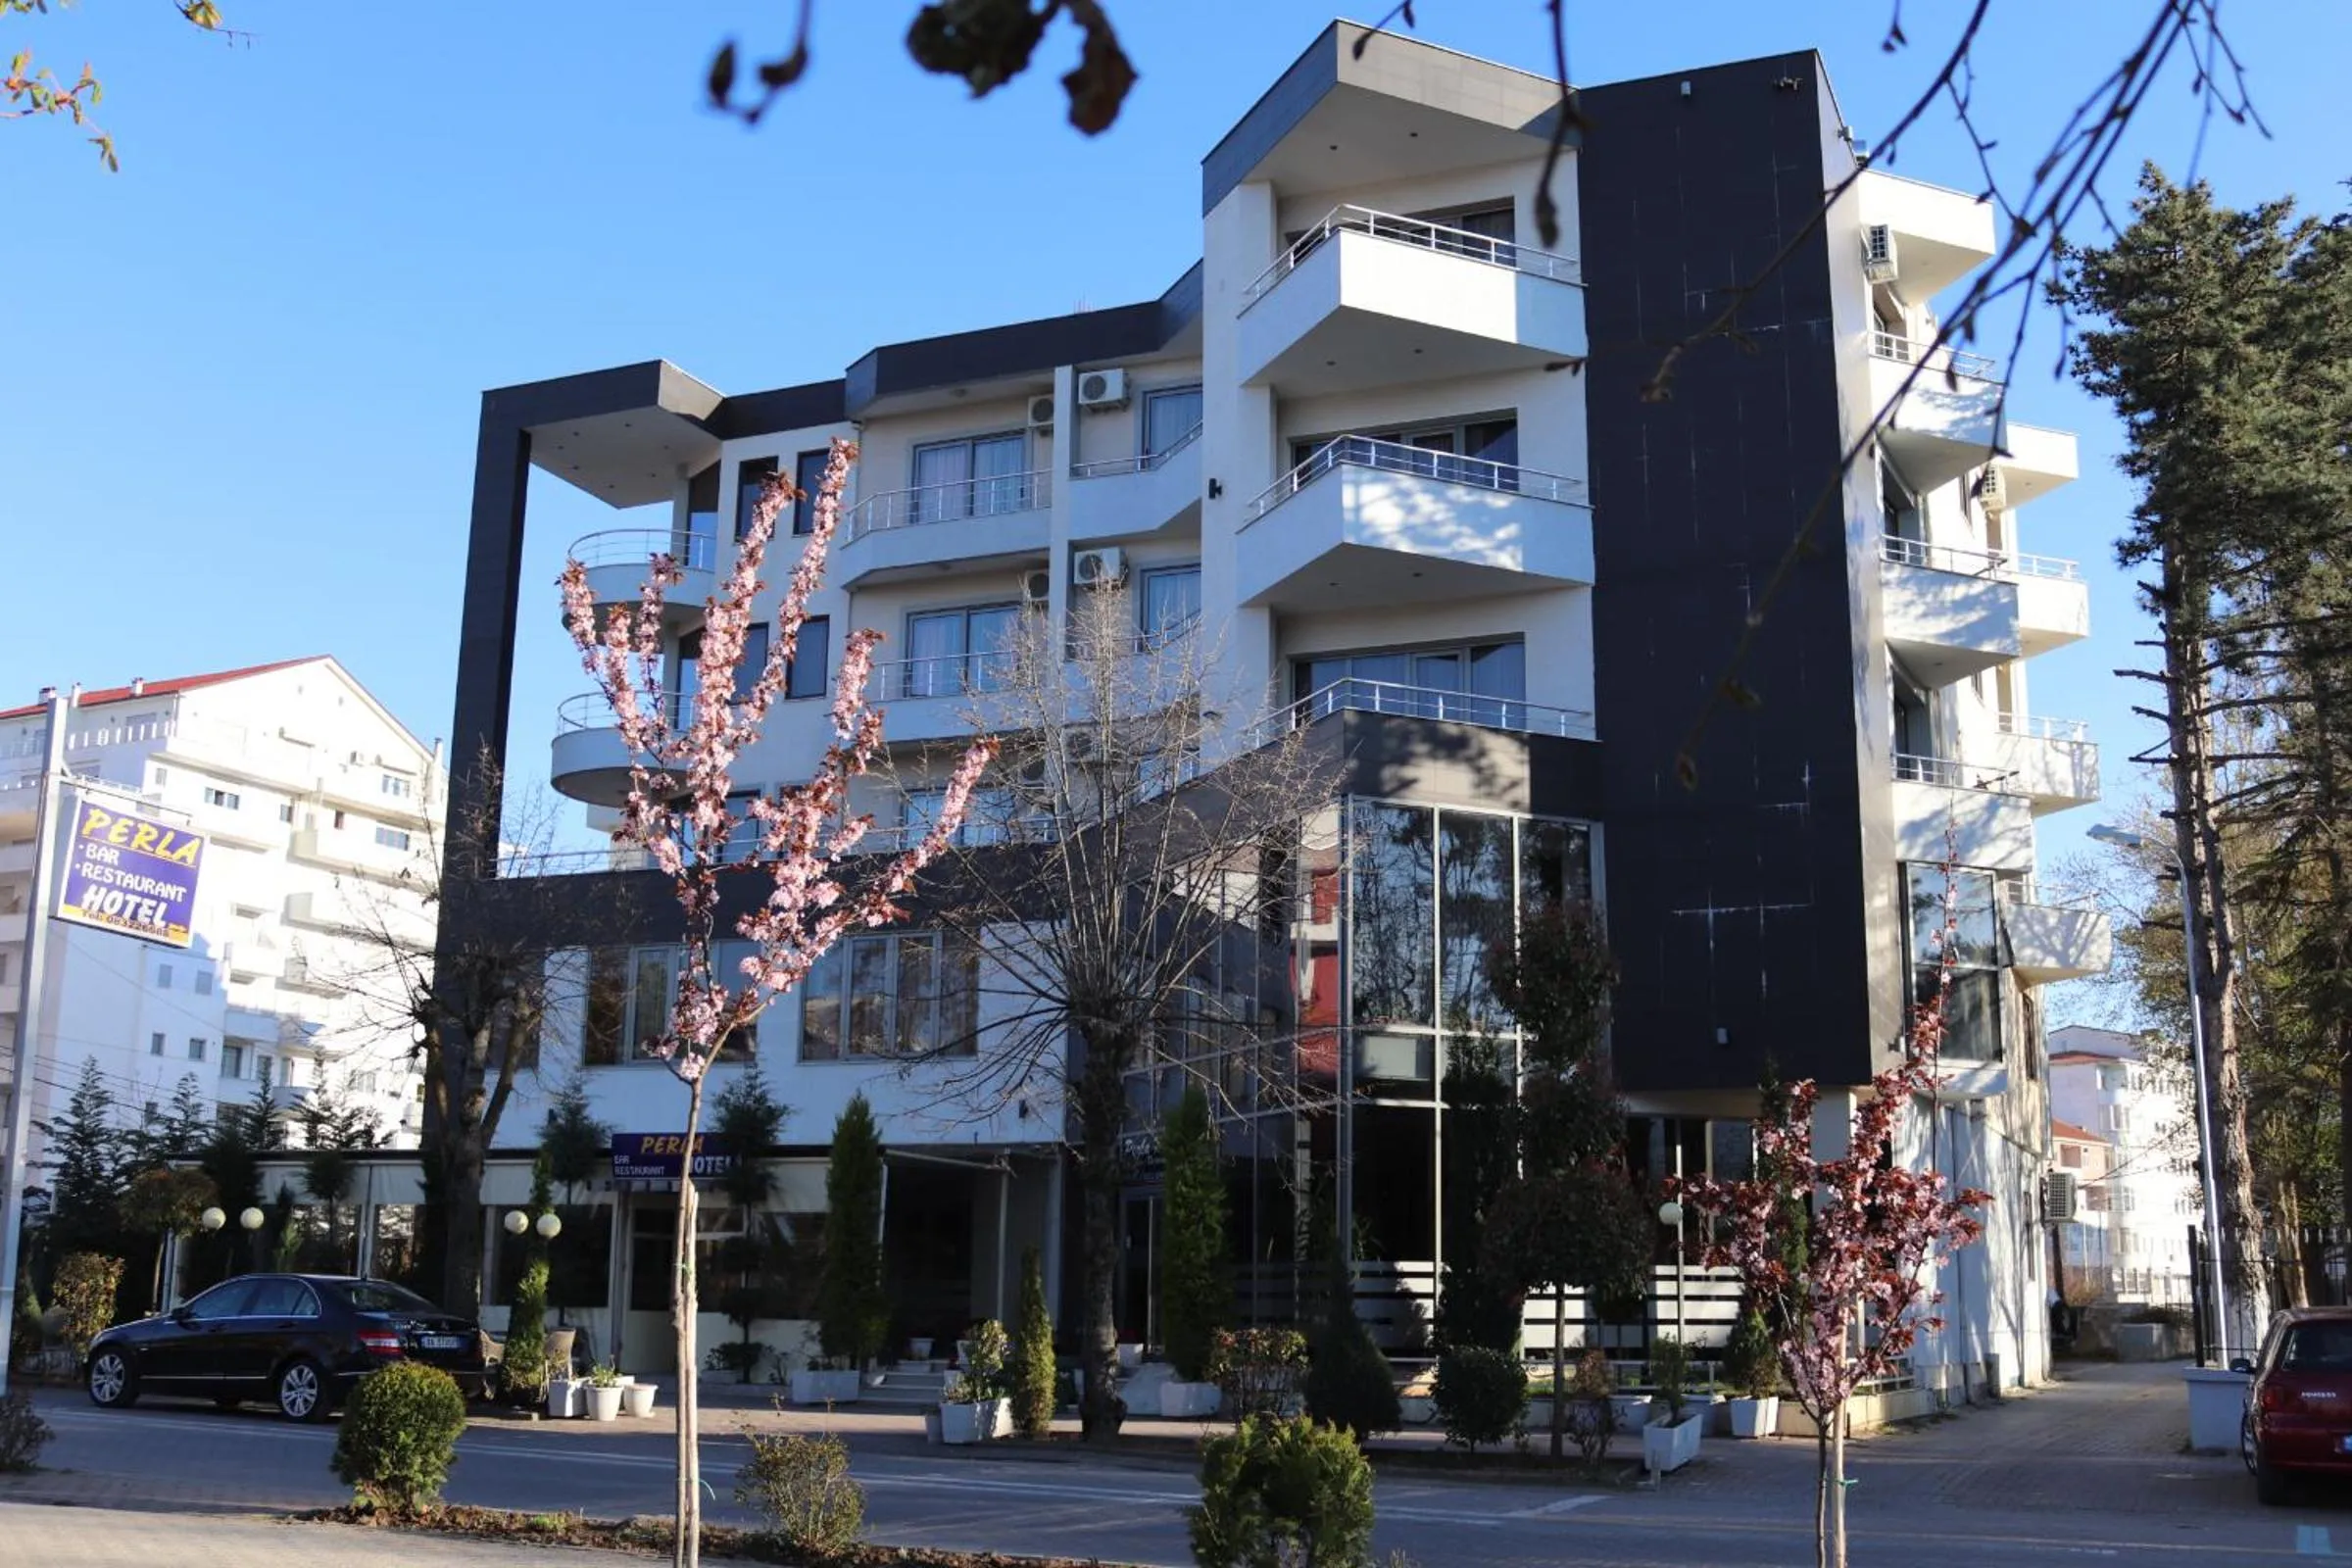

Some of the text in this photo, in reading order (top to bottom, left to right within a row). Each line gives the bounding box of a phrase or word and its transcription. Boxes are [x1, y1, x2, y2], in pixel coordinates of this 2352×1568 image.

[82, 808, 202, 864] PERLA
[85, 844, 120, 865] BAR
[81, 862, 186, 903] RESTAURANT
[81, 884, 169, 928] HOTEL
